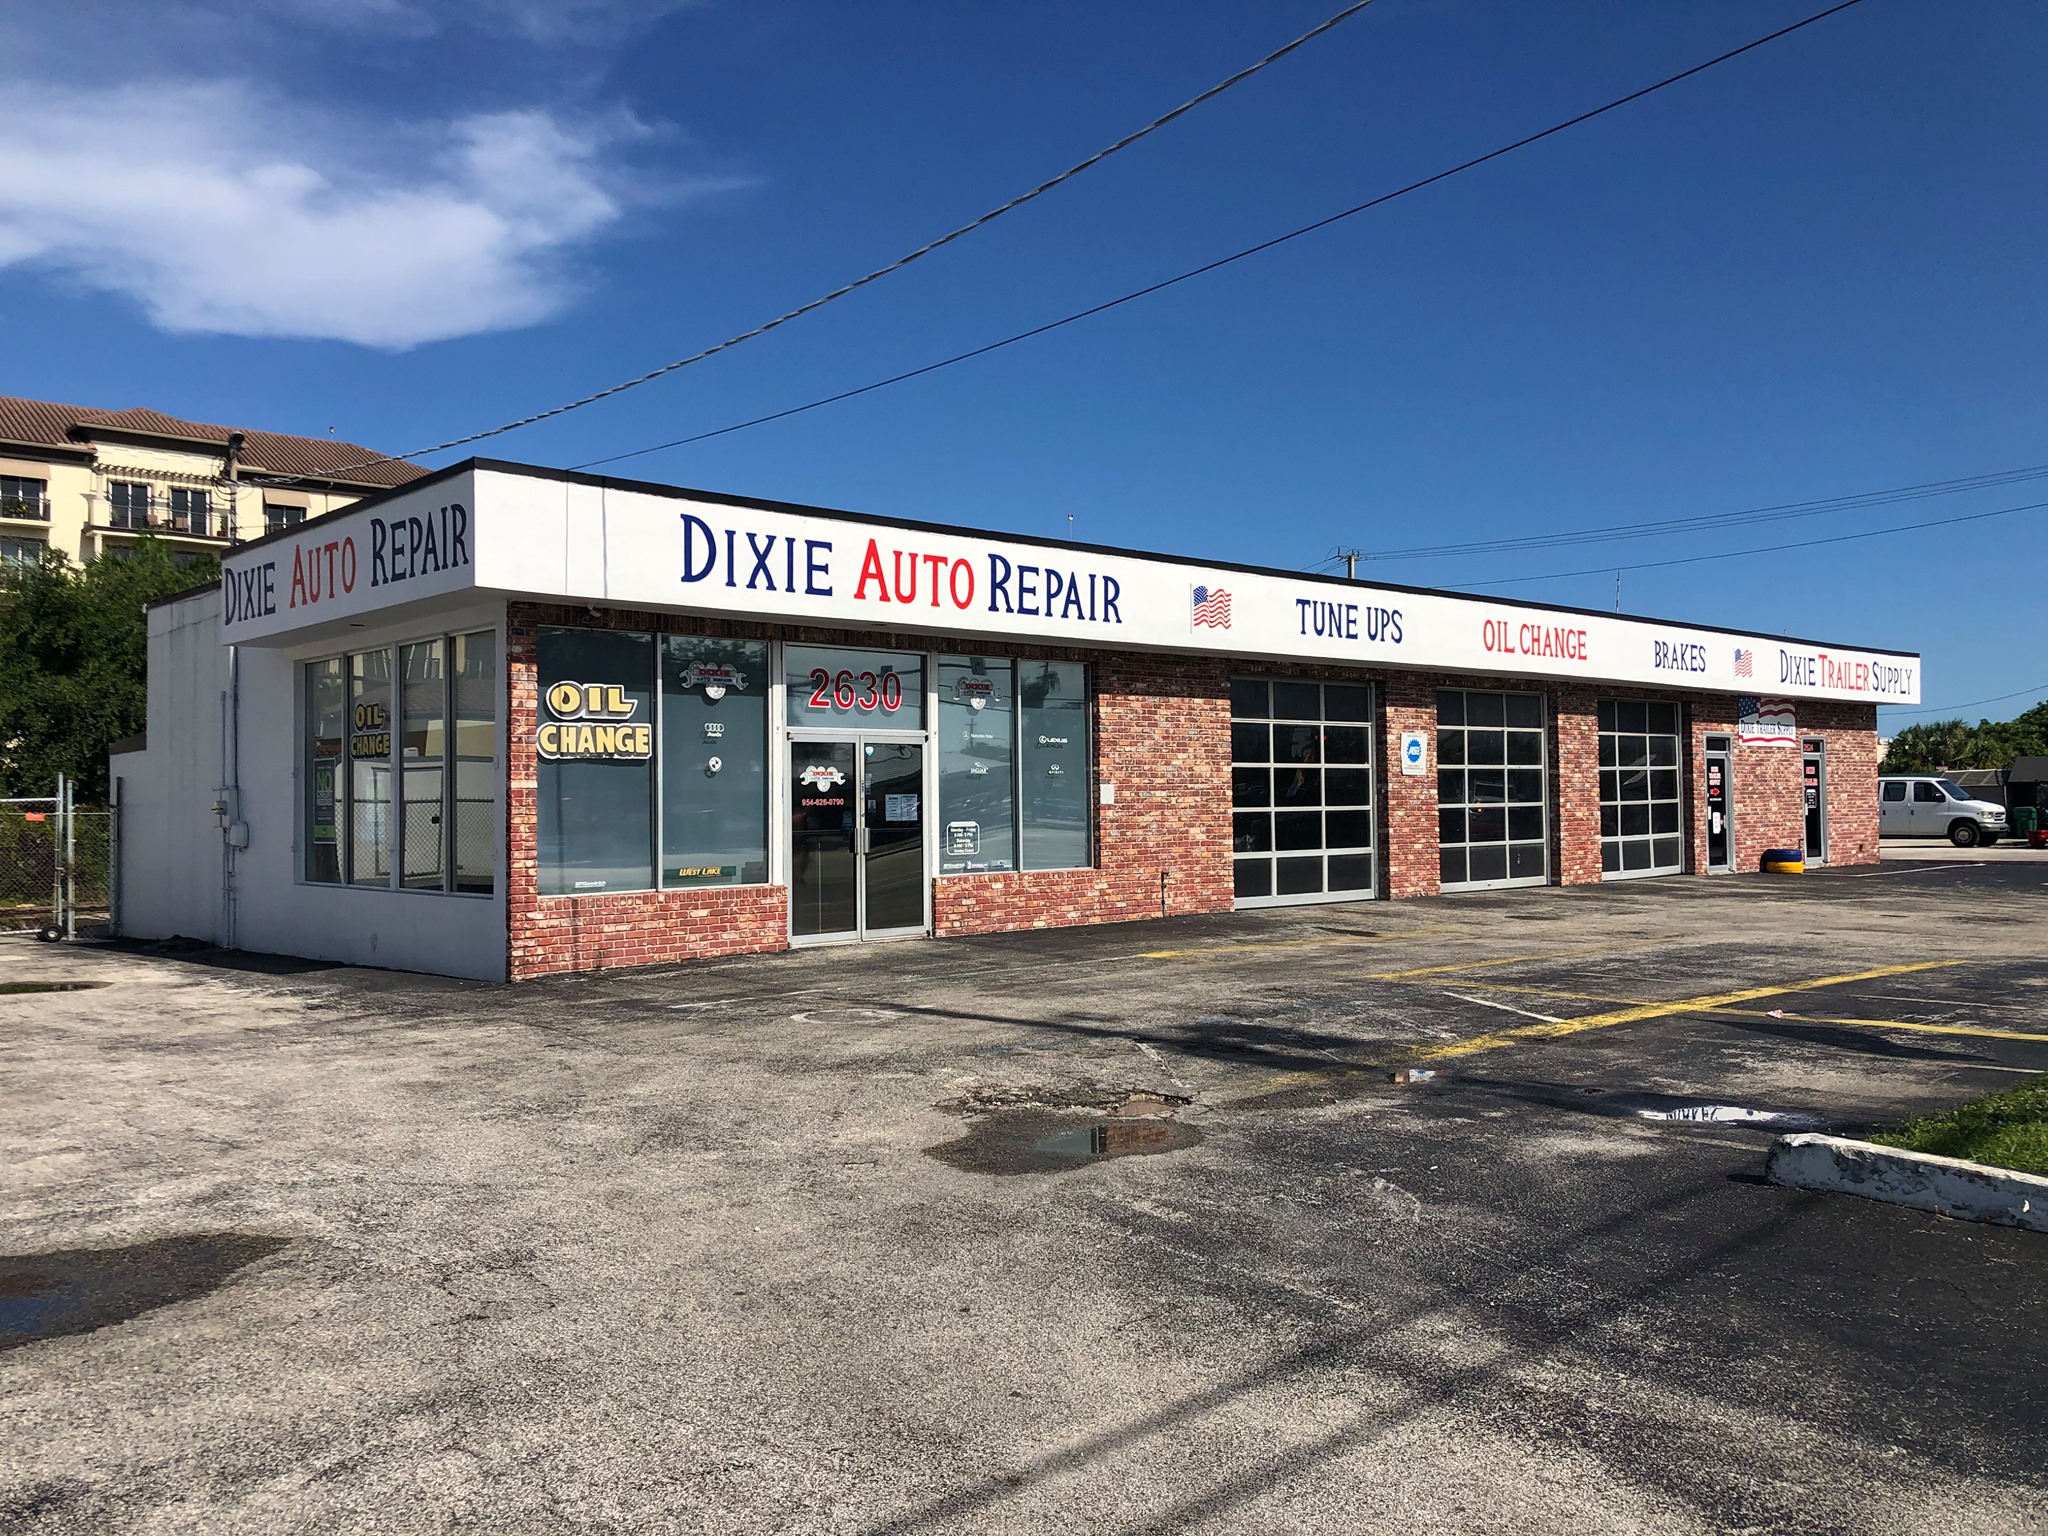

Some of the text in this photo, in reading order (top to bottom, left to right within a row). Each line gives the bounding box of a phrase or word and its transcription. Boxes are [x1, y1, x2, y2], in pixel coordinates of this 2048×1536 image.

[225, 504, 469, 626] DIXIE AUTO REPAIR
[680, 513, 1122, 624] DIXIE AUTO REPAIR
[1296, 598, 1403, 644] TUNE UPS
[1483, 619, 1588, 660] OIL CHANGE
[1654, 640, 1706, 673] BRAKES
[1779, 649, 1912, 695] DIXIE TRAILER SUPPLY
[549, 683, 635, 714] OIL
[808, 668, 902, 711] 2630
[354, 703, 384, 731] OIL
[351, 733, 391, 758] CHANGE
[538, 724, 650, 757] CHANGE
[316, 771, 332, 790] NO
